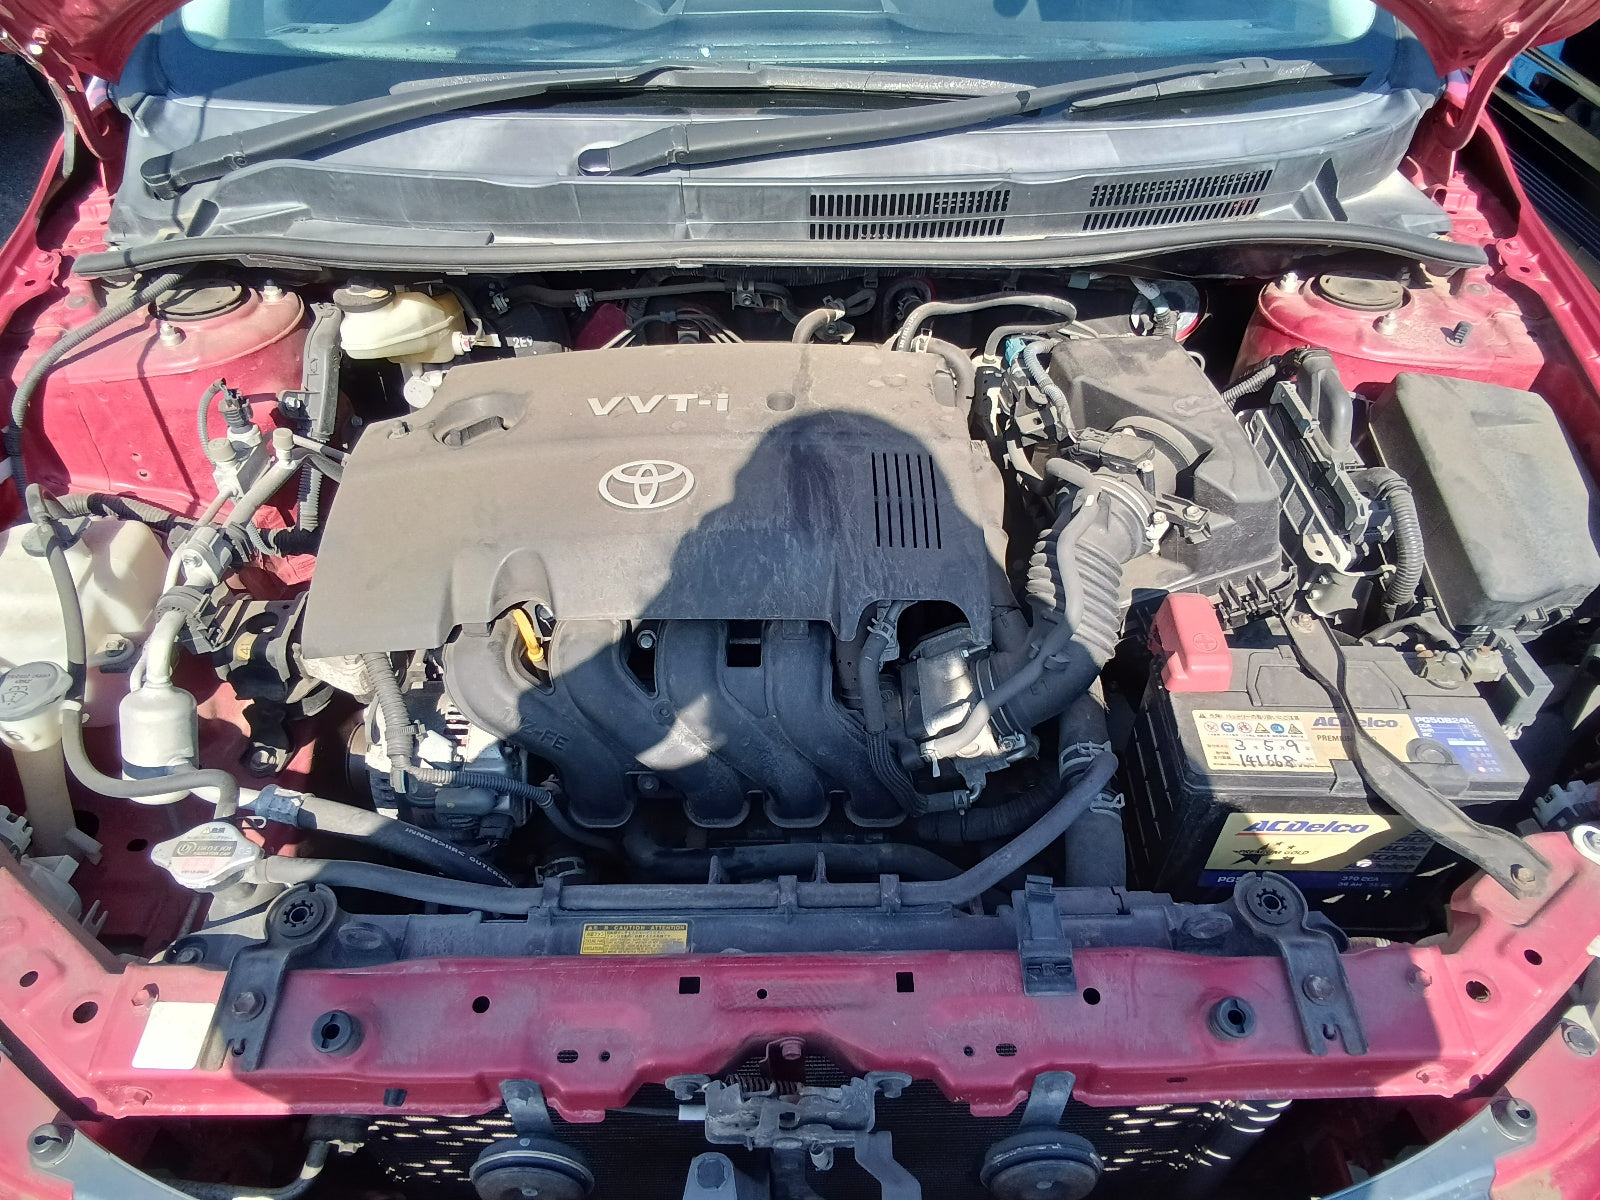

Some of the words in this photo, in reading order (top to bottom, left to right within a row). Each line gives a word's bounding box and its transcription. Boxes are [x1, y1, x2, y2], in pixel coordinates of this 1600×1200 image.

[587, 392, 729, 416] VVT-i
[1234, 739, 1247, 751] 3
[1263, 739, 1274, 751] 5
[1286, 739, 1301, 753] 9
[1242, 820, 1370, 833] ACDelco
